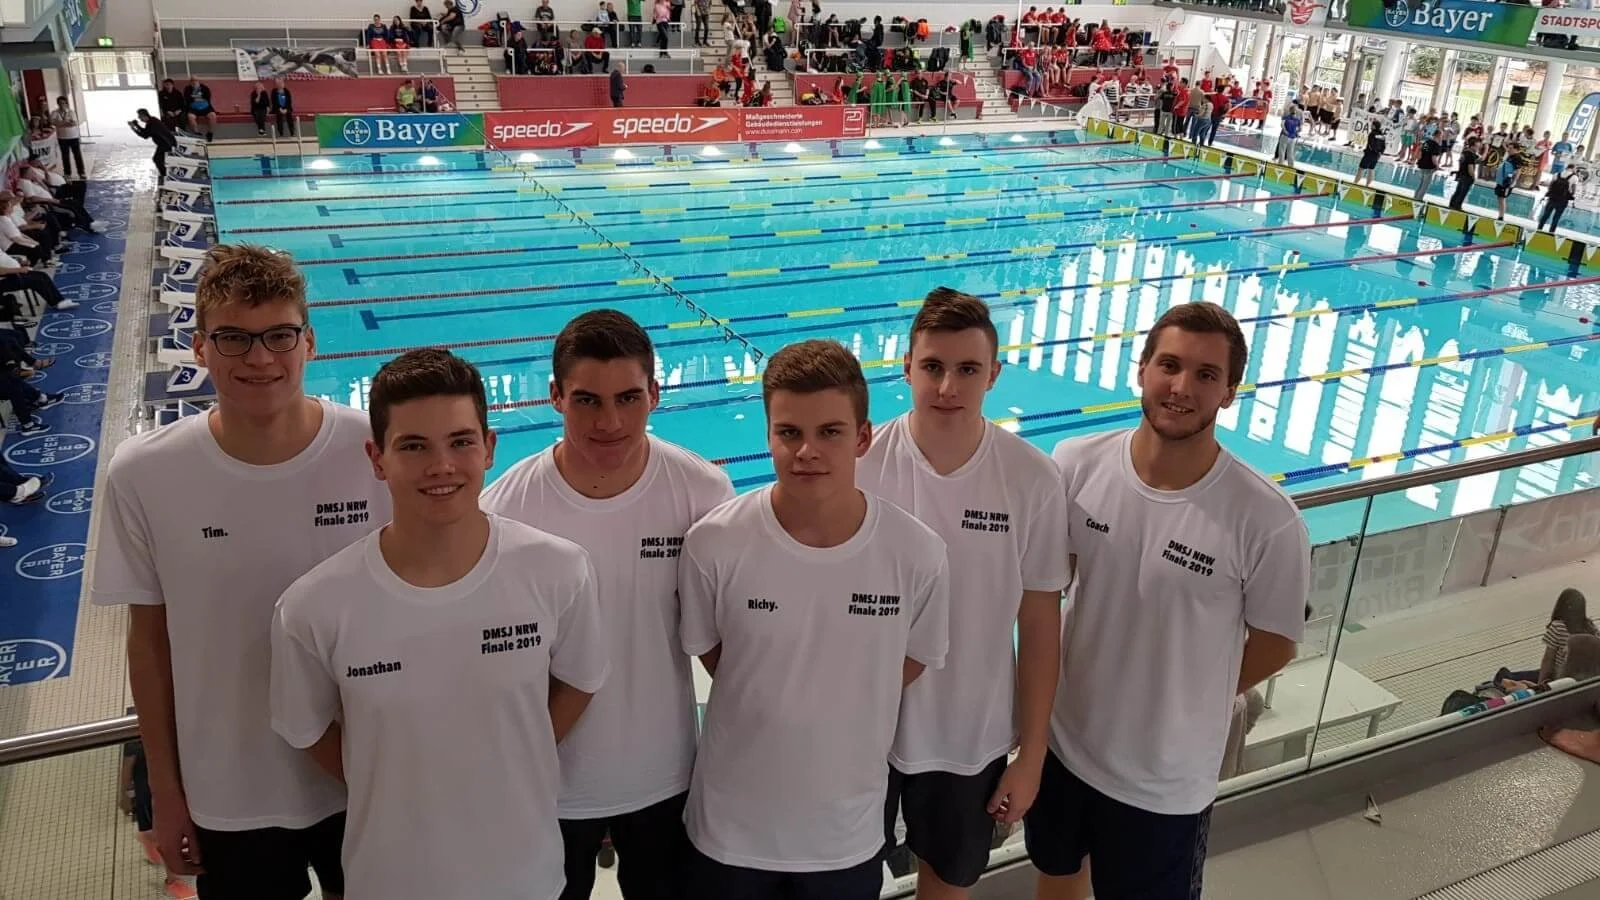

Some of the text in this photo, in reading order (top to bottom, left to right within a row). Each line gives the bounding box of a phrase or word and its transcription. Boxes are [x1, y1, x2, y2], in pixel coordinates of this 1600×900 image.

[1412, 2, 1493, 33] Bayer
[376, 120, 460, 144] Bayer
[493, 121, 563, 142] speedo
[612, 114, 695, 138] speedo
[180, 310, 188, 320] 4
[181, 370, 191, 382] 3
[316, 500, 368, 514] DMSJ NRW
[314, 512, 369, 526] Finale 2019
[964, 509, 1009, 522] DMSJ NRW
[201, 526, 229, 539] Tim.
[961, 520, 1010, 533] Finale 2019
[1085, 518, 1110, 534] Coach
[641, 537, 665, 547] DMSJ
[640, 548, 681, 559] Finale 201
[1168, 540, 1216, 566] DMSJ NRW
[49, 546, 67, 576] BAYER
[1161, 550, 1214, 577] Finale 2019
[748, 599, 778, 612] Richy.
[851, 593, 900, 606] DMSJ NRW
[849, 605, 900, 616] Finale 2019
[482, 622, 538, 641] DMSJ NRW
[481, 635, 541, 655] Finale 2019
[0, 644, 17, 686] AYER
[346, 661, 402, 678] Jonathan
